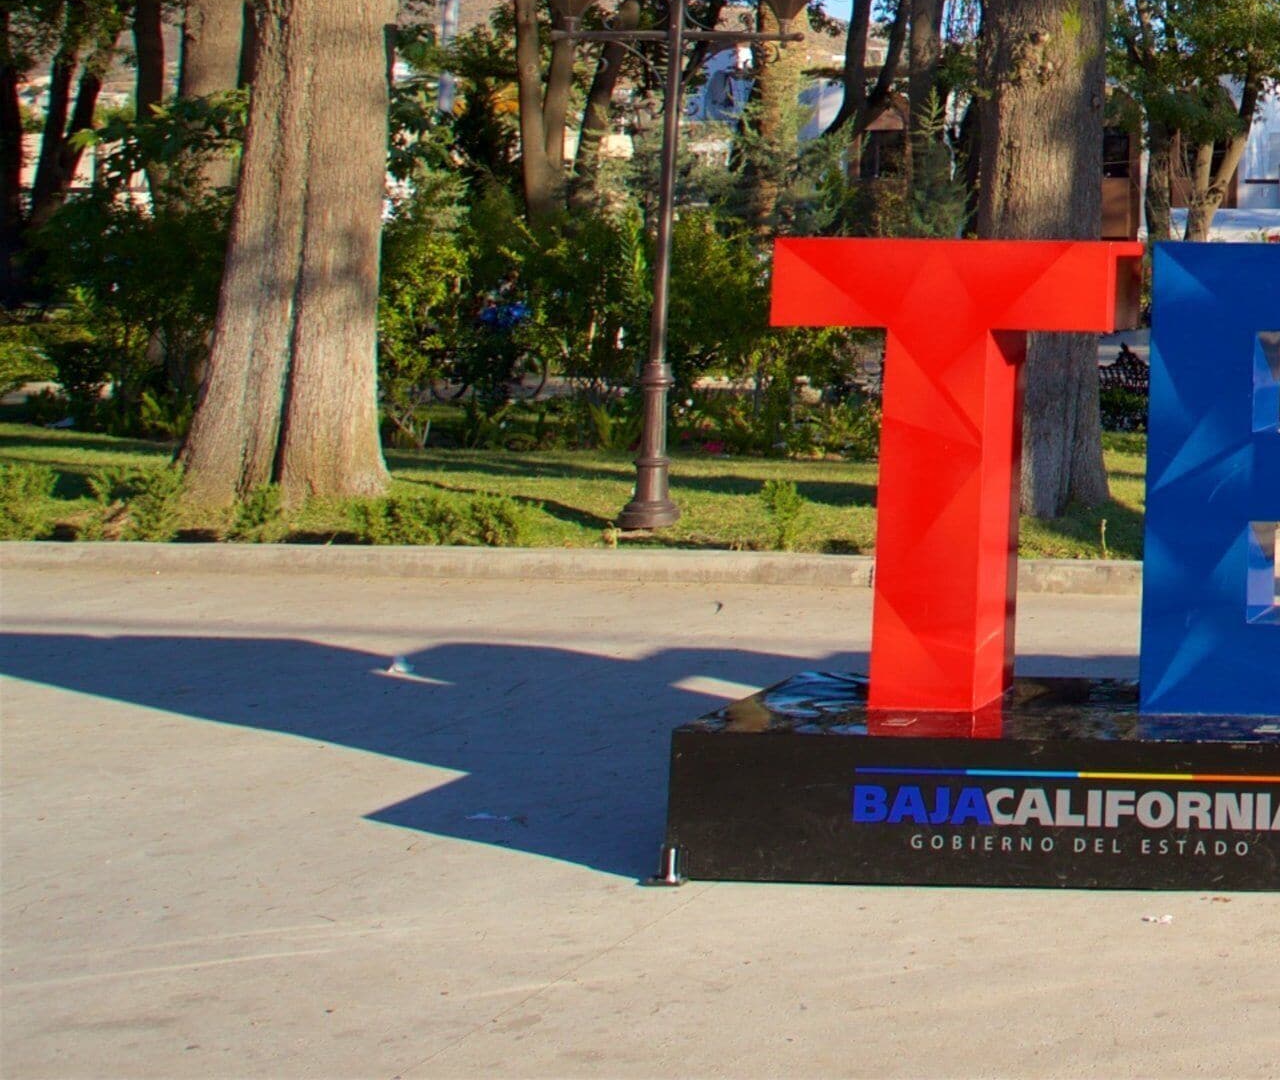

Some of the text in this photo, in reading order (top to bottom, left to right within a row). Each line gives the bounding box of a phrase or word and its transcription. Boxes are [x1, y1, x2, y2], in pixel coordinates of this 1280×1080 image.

[910, 834, 1250, 856] GOBIERNO DEL ESTADO
